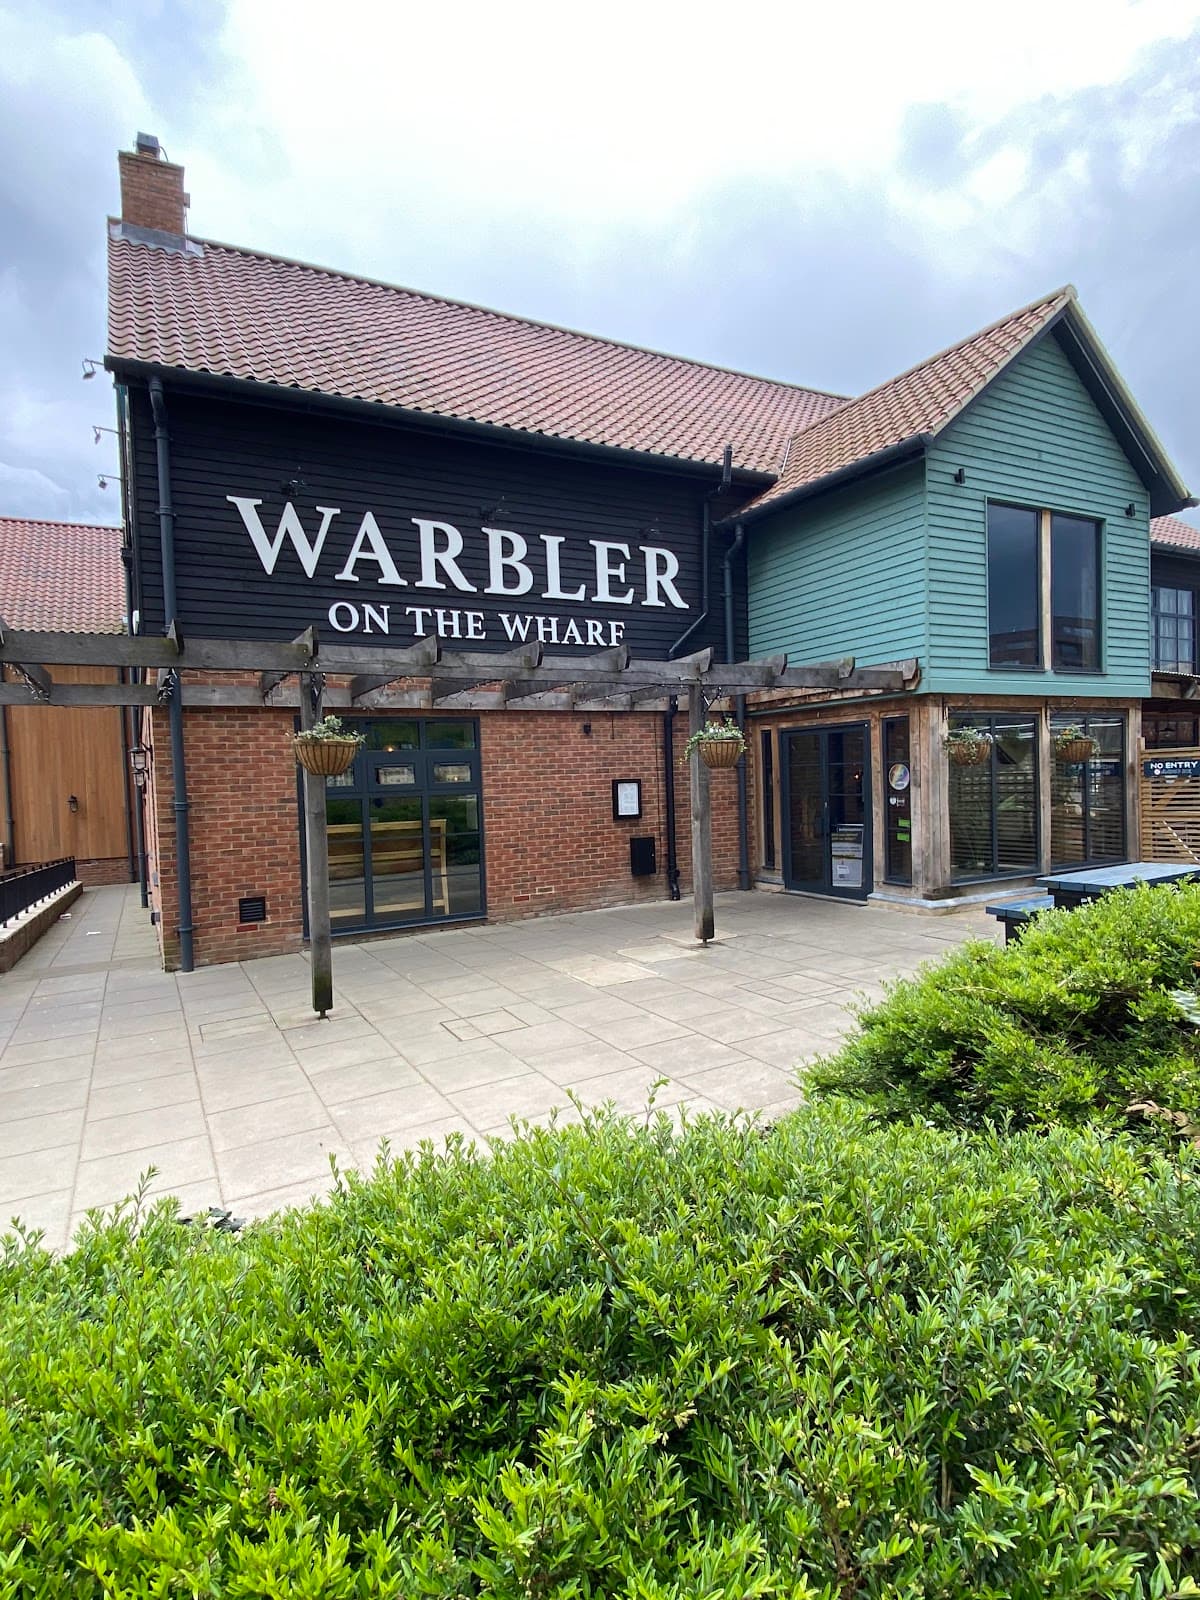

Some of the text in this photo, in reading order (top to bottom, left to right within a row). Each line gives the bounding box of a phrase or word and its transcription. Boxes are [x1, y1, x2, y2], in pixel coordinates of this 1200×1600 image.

[226, 495, 690, 609] WARBLER
[328, 601, 626, 647] ON THE WHARF
[1165, 761, 1198, 769] ENTRY
